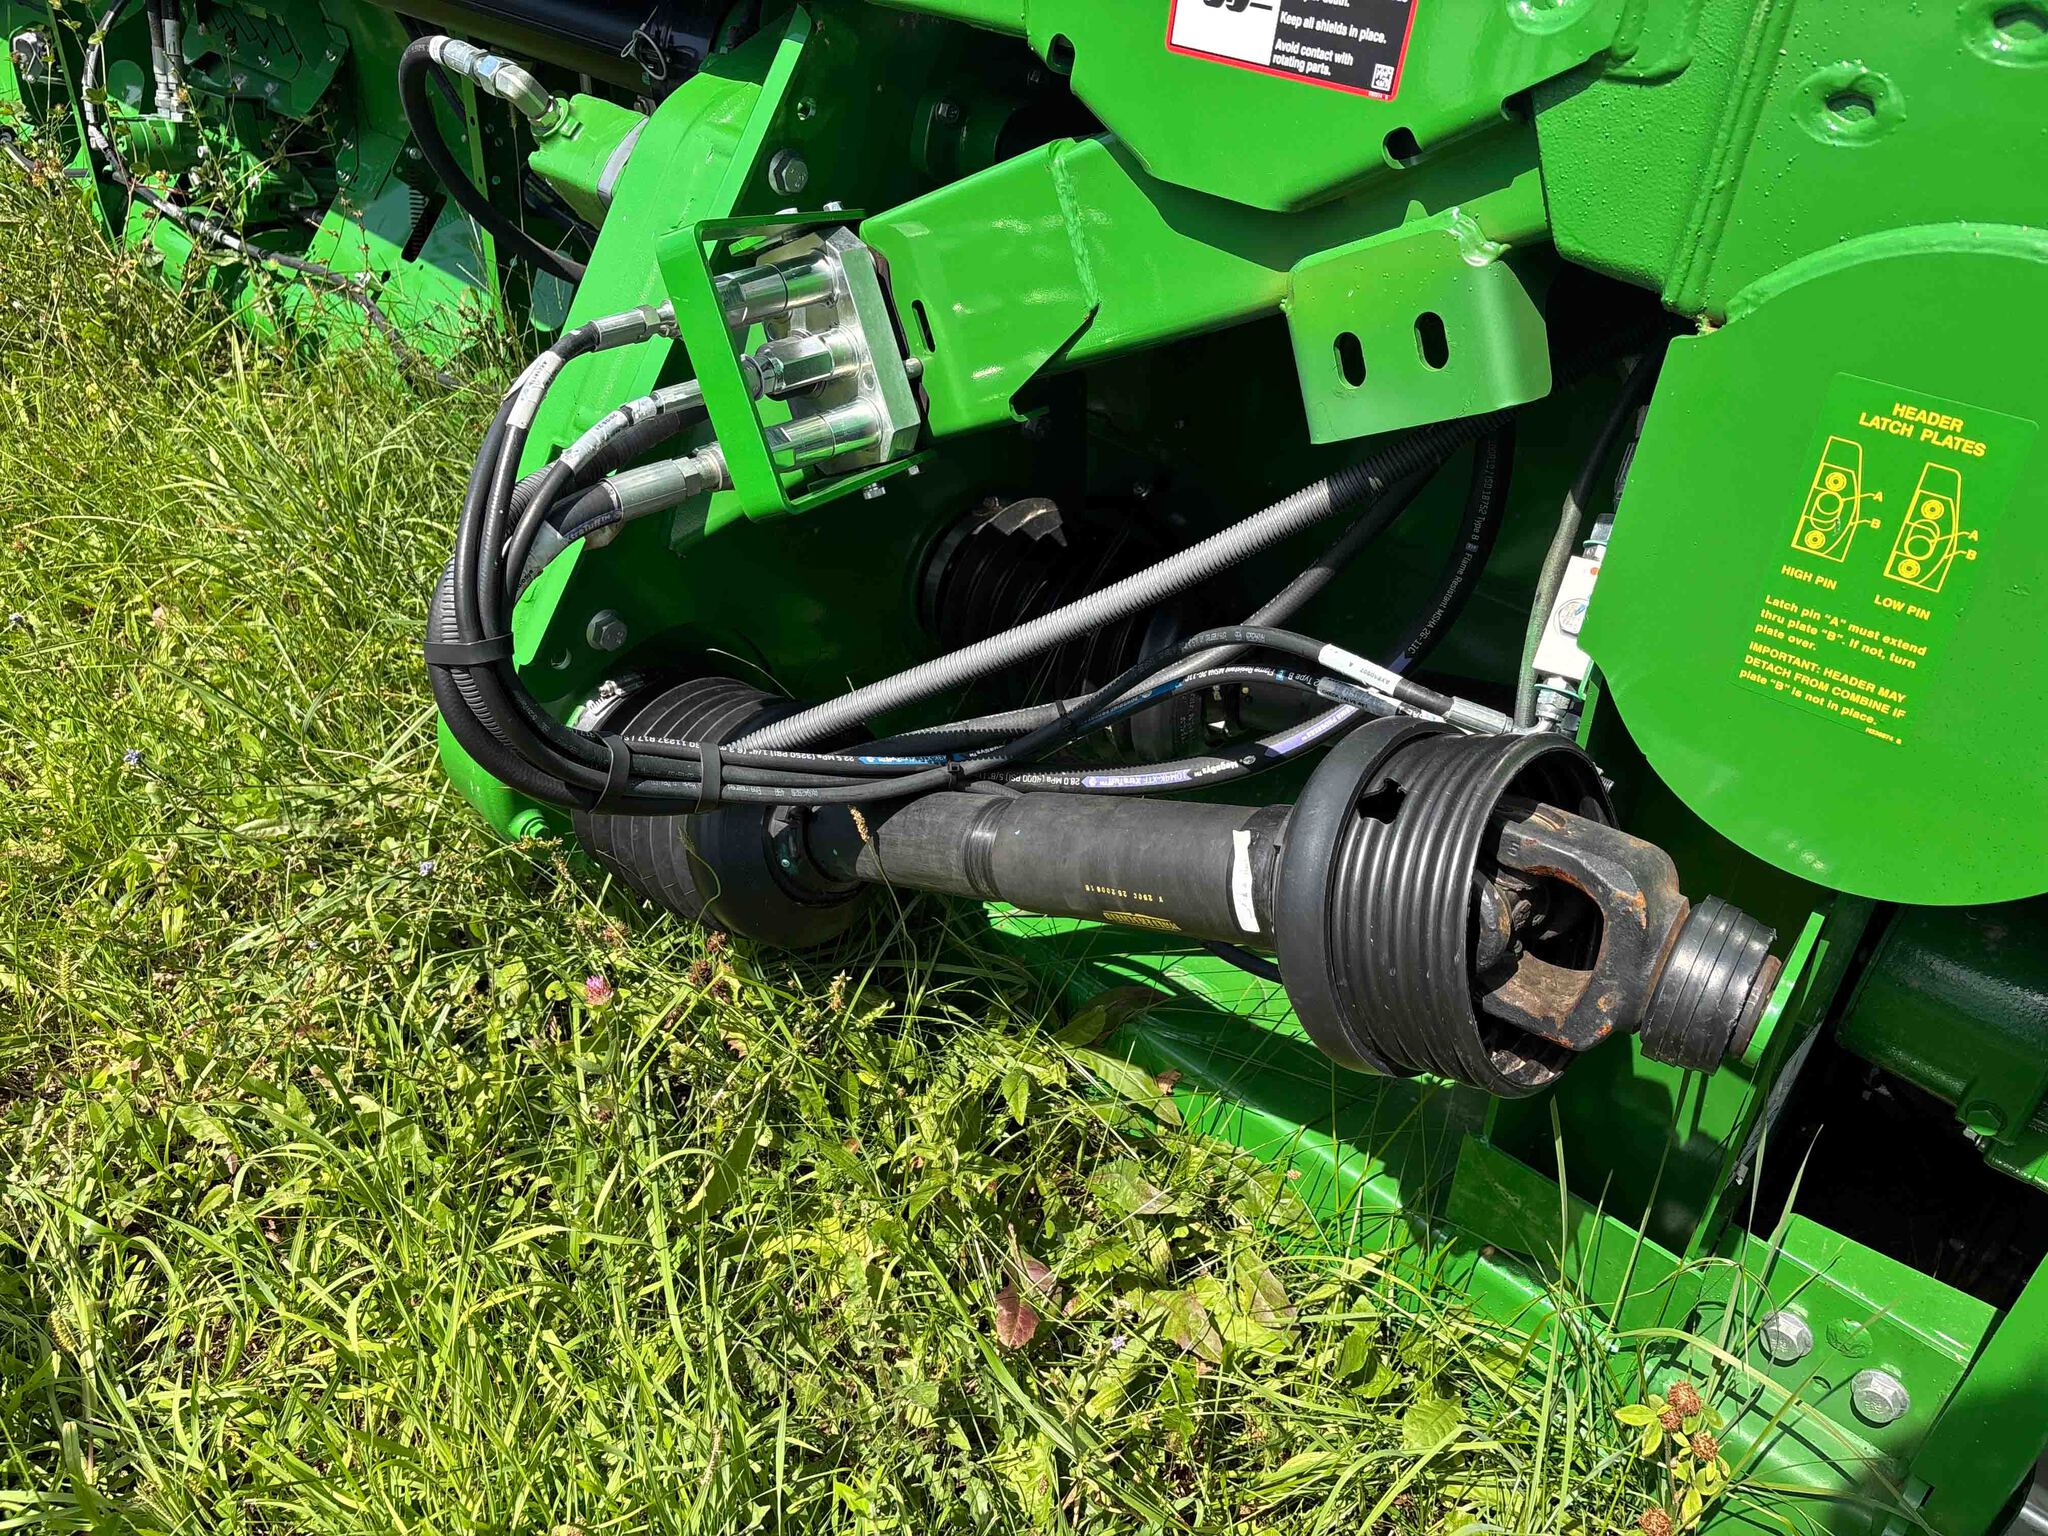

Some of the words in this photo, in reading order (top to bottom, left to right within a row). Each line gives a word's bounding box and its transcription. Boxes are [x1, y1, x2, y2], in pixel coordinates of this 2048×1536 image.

[1280, 11, 1302, 30] Keep
[1303, 16, 1315, 28] all
[1316, 18, 1348, 36] shields
[1349, 24, 1358, 38] in
[1359, 26, 1387, 44] place.
[1275, 38, 1299, 54] Avoid
[1301, 44, 1333, 61] contact
[1335, 50, 1354, 66] with
[1273, 54, 1305, 73] rotating
[1306, 61, 1331, 76] parts.
[1892, 403, 1964, 433] HEADER
[1858, 412, 1914, 437] LATCH
[1920, 428, 1987, 457] PLATES
[1873, 491, 1883, 502] A
[1870, 518, 1881, 529] B
[1968, 530, 1978, 541] A
[1457, 552, 1473, 575] Flame
[1965, 549, 1977, 561] B
[1781, 564, 1814, 583] HIGH
[1815, 574, 1838, 590] PIN
[1440, 575, 1463, 609] Resistant
[1426, 608, 1444, 629] MSHA
[1873, 594, 1905, 612] LOW
[1906, 604, 1931, 621] PIN
[1755, 622, 1785, 640] plate
[1788, 635, 1817, 651] over.
[1765, 594, 1799, 613] Latch
[1800, 608, 1822, 622] pin
[1848, 622, 1880, 640] must
[1882, 635, 1927, 656] extend
[1760, 608, 1785, 625] thru
[1787, 617, 1819, 636] plate
[1849, 638, 1860, 649] If
[1861, 643, 1886, 660] not,
[1889, 652, 1917, 670] turn
[1225, 666, 1254, 675] Resistant
[1254, 666, 1275, 676] Flame
[1295, 673, 1313, 684] Type
[1749, 641, 1822, 675] IMPORTANT:
[1823, 667, 1876, 693] HEADER
[1878, 687, 1907, 704] MAY
[1739, 669, 1767, 686] plate
[1791, 687, 1803, 698] is
[1804, 693, 1825, 707] not
[1826, 700, 1840, 711] in
[1840, 705, 1877, 726] place.
[1744, 654, 1792, 679] DETACH
[1793, 672, 1830, 692] FROM
[1831, 686, 1891, 715] COMBINE
[1892, 707, 1907, 720] IF
[1022, 774, 1045, 785] (4000
[1047, 775, 1063, 785] MPa
[1064, 777, 1080, 786] 28.0
